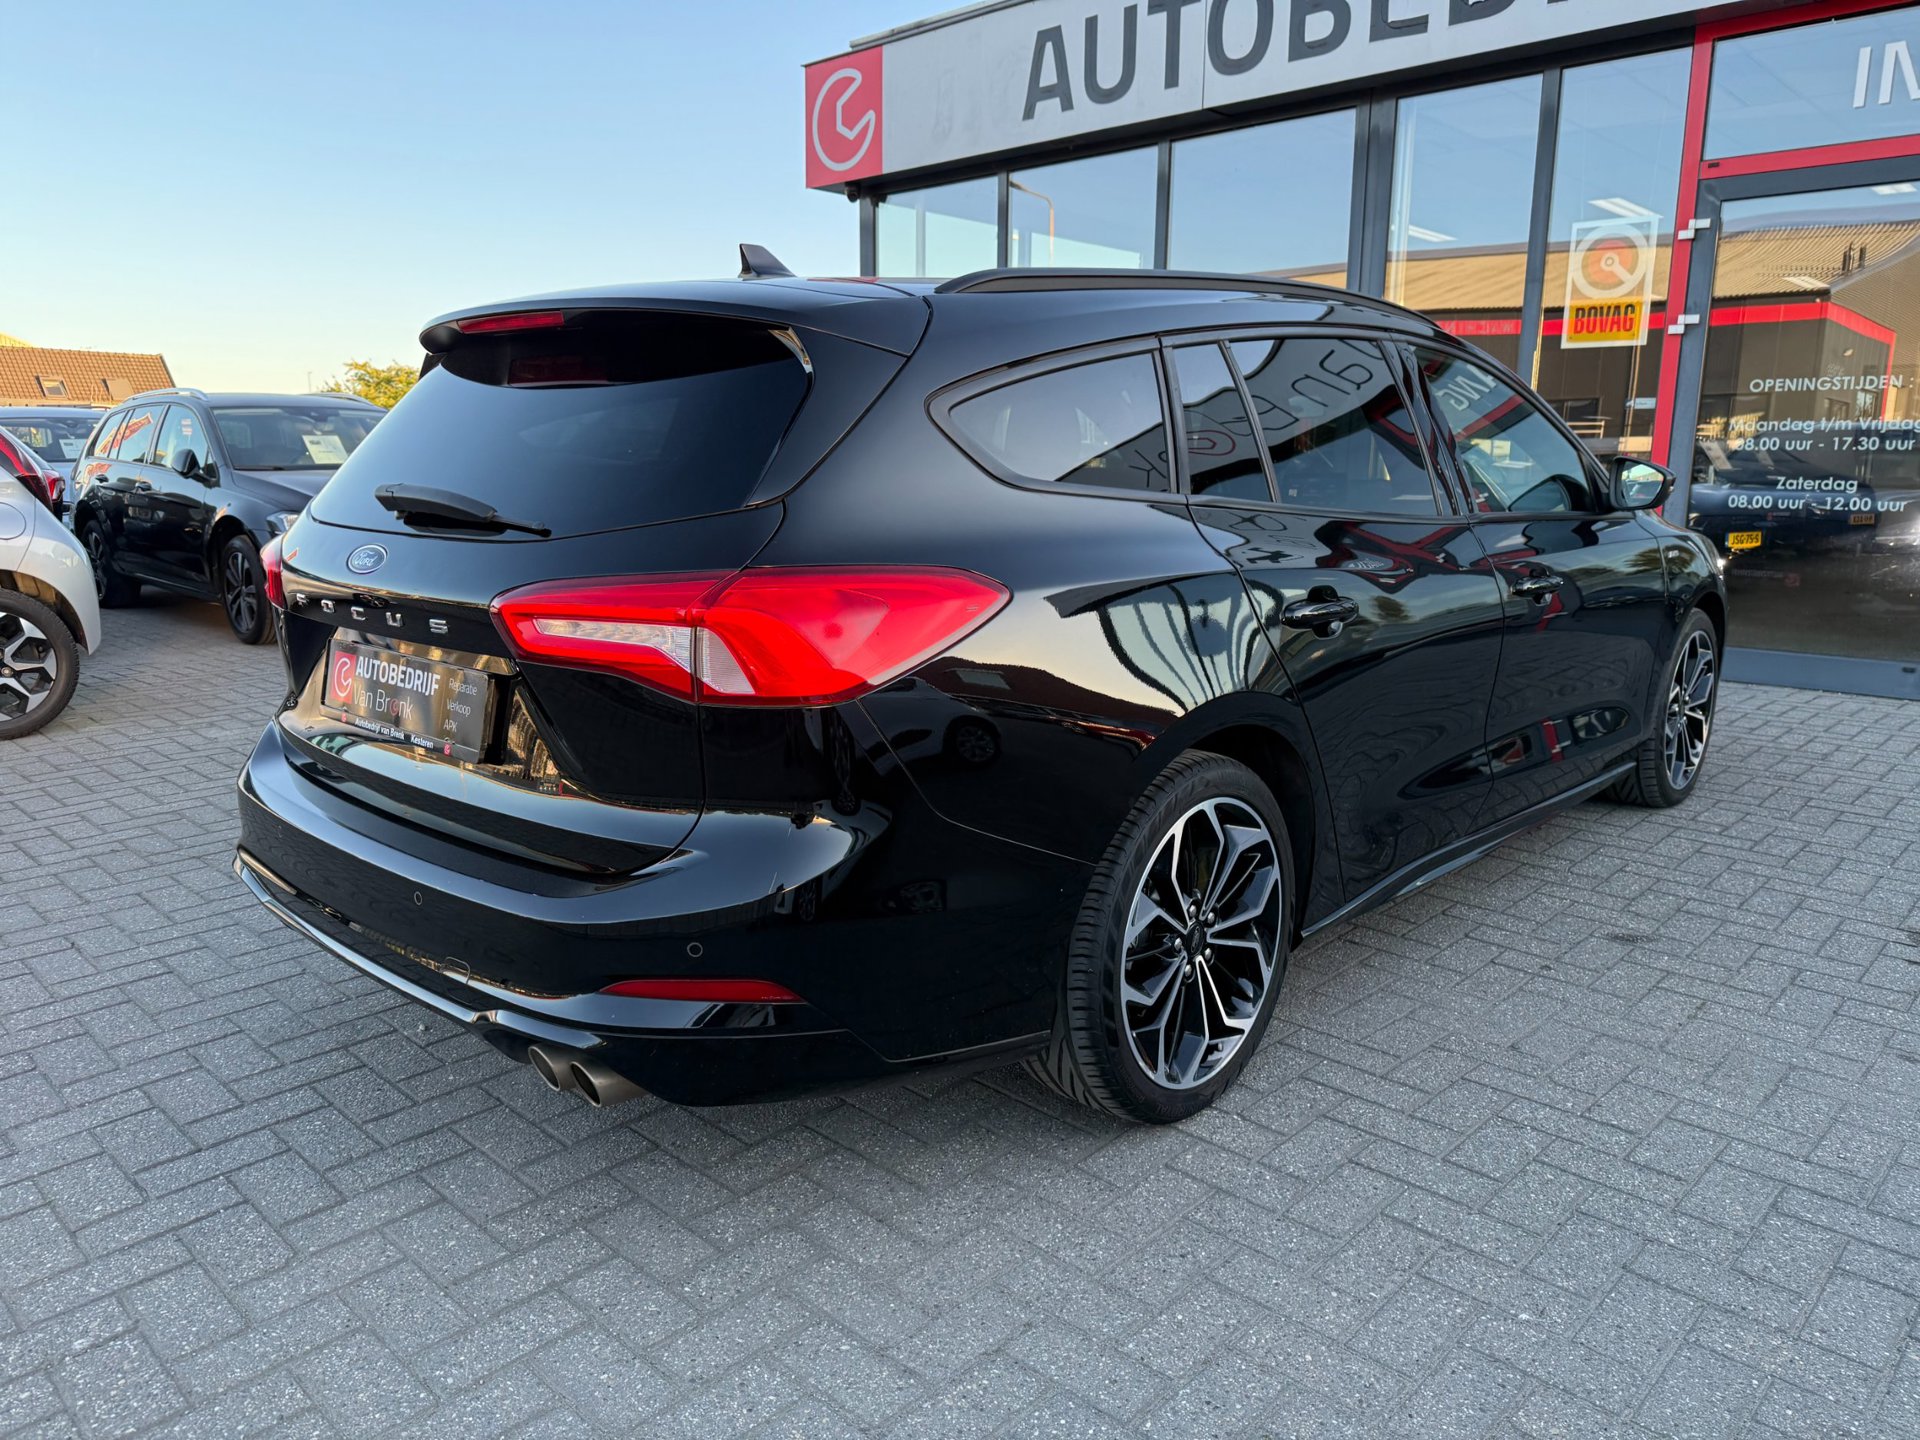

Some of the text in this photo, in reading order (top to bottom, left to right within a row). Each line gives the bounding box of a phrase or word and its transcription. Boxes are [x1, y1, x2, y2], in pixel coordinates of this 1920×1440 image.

[1573, 304, 1635, 334] BOVAG
[1750, 375, 1903, 392] OPENINGSTIJDEN
[1729, 417, 1815, 434] Maandag
[1820, 417, 1851, 433] t/m
[1785, 439, 1813, 451] uur
[1833, 437, 1879, 451] 17.30
[1885, 438, 1916, 450] uur
[1776, 476, 1858, 493] Zaterdag
[1728, 495, 1772, 509] 08.00
[1778, 497, 1806, 509] uur
[1825, 497, 1871, 511] 12.00
[1877, 500, 1907, 512] uur
[353, 550, 378, 567] Ford
[296, 593, 448, 634] FOCUS
[355, 656, 440, 696] AUTOBEDRIJF
[353, 683, 373, 708] Van
[446, 698, 472, 718] Verkoop
[443, 719, 458, 733] APK
[410, 735, 434, 748] Kesteren
